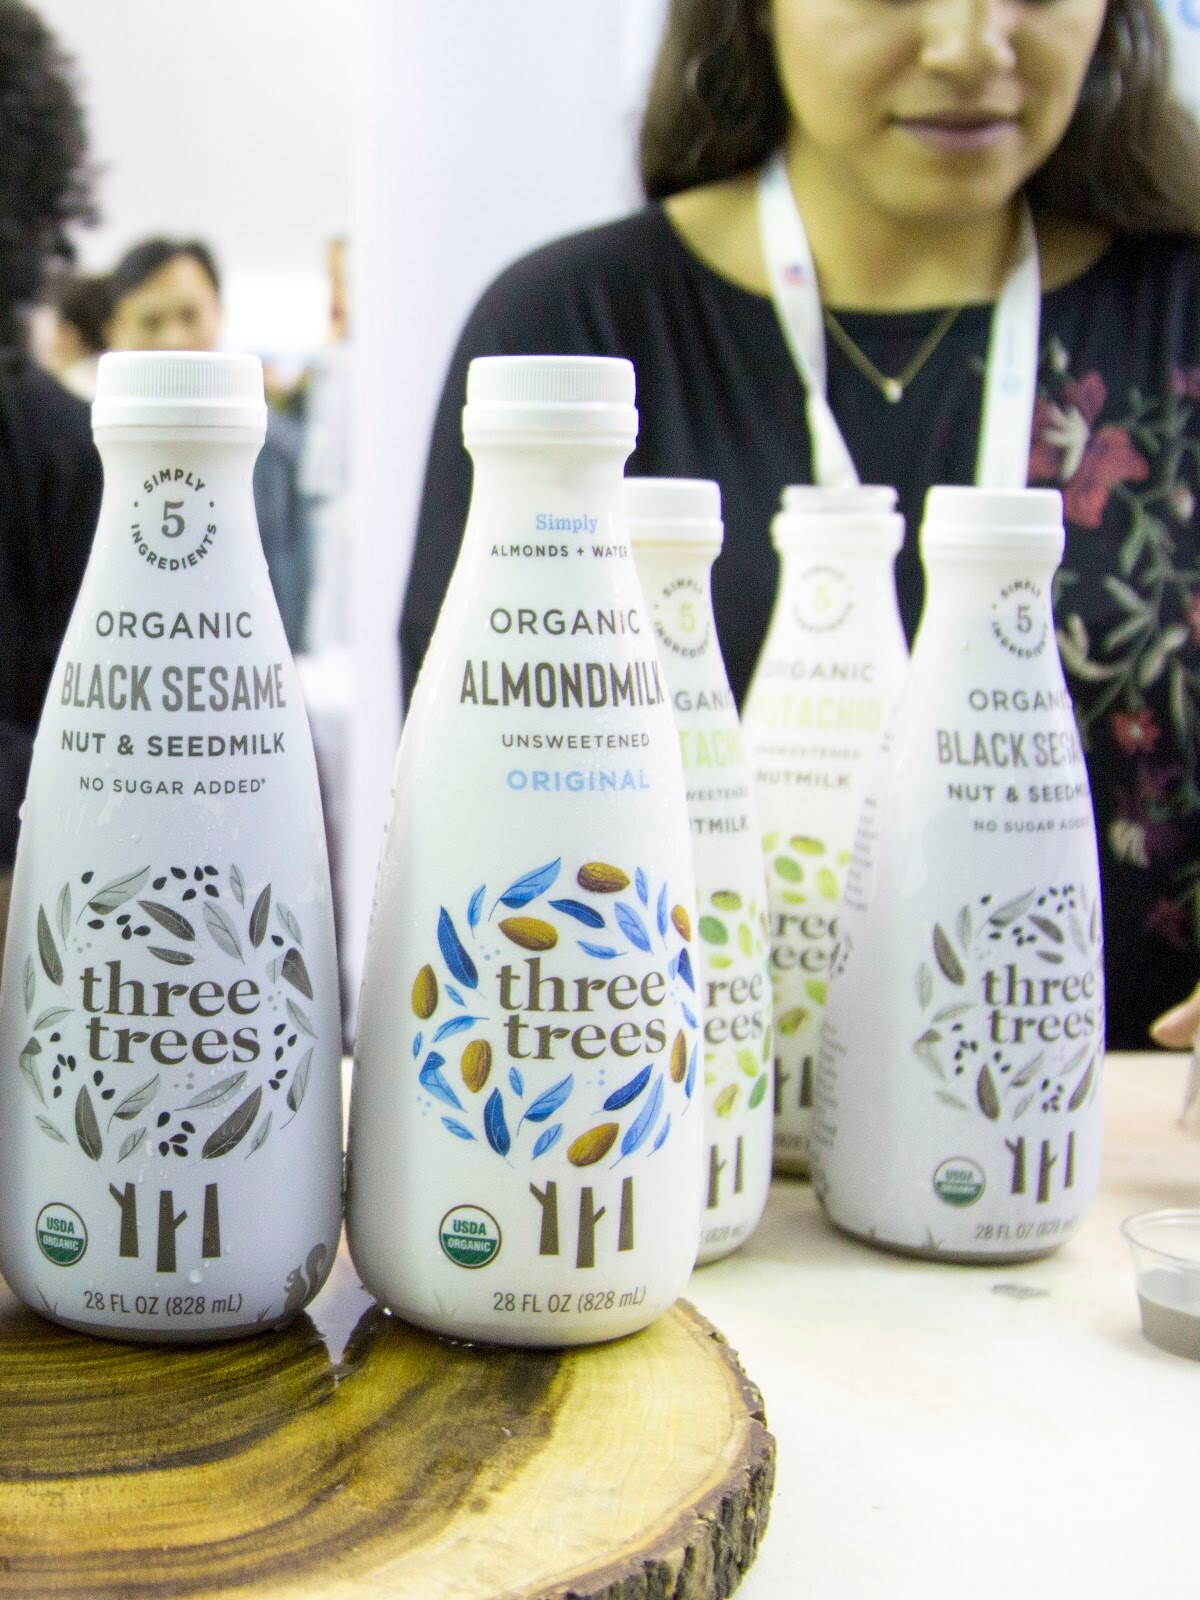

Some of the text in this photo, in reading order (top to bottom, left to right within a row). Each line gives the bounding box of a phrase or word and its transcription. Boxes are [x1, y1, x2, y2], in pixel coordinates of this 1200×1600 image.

[144, 468, 206, 493] SIMPLY
[161, 501, 185, 538] 5
[536, 514, 598, 534] Simply
[131, 524, 216, 571] INGREDIENTS
[491, 545, 628, 558] ALMONDS + WATER
[96, 610, 252, 639] ORGANIC
[490, 608, 640, 635] ORGANIC
[679, 603, 696, 633] 5
[1015, 604, 1032, 634] 5
[61, 660, 286, 712] BLACK SESAME
[460, 659, 665, 708] ALMONDMILK
[62, 730, 285, 757] NUT & SEEDMILK
[502, 734, 649, 748] UNSWEETENED
[936, 727, 1031, 768] BLACK
[80, 777, 104, 792] NO
[113, 780, 184, 795] SUGAR
[507, 769, 650, 792] ORIGINAL
[948, 783, 996, 802] NUT
[1006, 784, 1020, 804] &
[974, 817, 998, 832] NO
[1004, 817, 1056, 833] SUGAR
[80, 960, 261, 1017] three
[496, 958, 665, 1012] three
[706, 973, 763, 1009] ree
[982, 963, 1094, 1006] three
[504, 1015, 667, 1059] trees
[704, 1010, 763, 1045] ees
[989, 1008, 1094, 1044] trees
[86, 1017, 261, 1065] trees
[46, 1217, 75, 1234] USDA
[453, 1220, 486, 1236] USDA
[975, 1225, 995, 1240] 28
[43, 1235, 79, 1252] ORGANIC
[447, 1237, 491, 1253] ORGANIC
[84, 1290, 242, 1317] 28 FL OZ (828 mL)
[493, 1287, 647, 1313] 28 FL OZ (828 mL)
